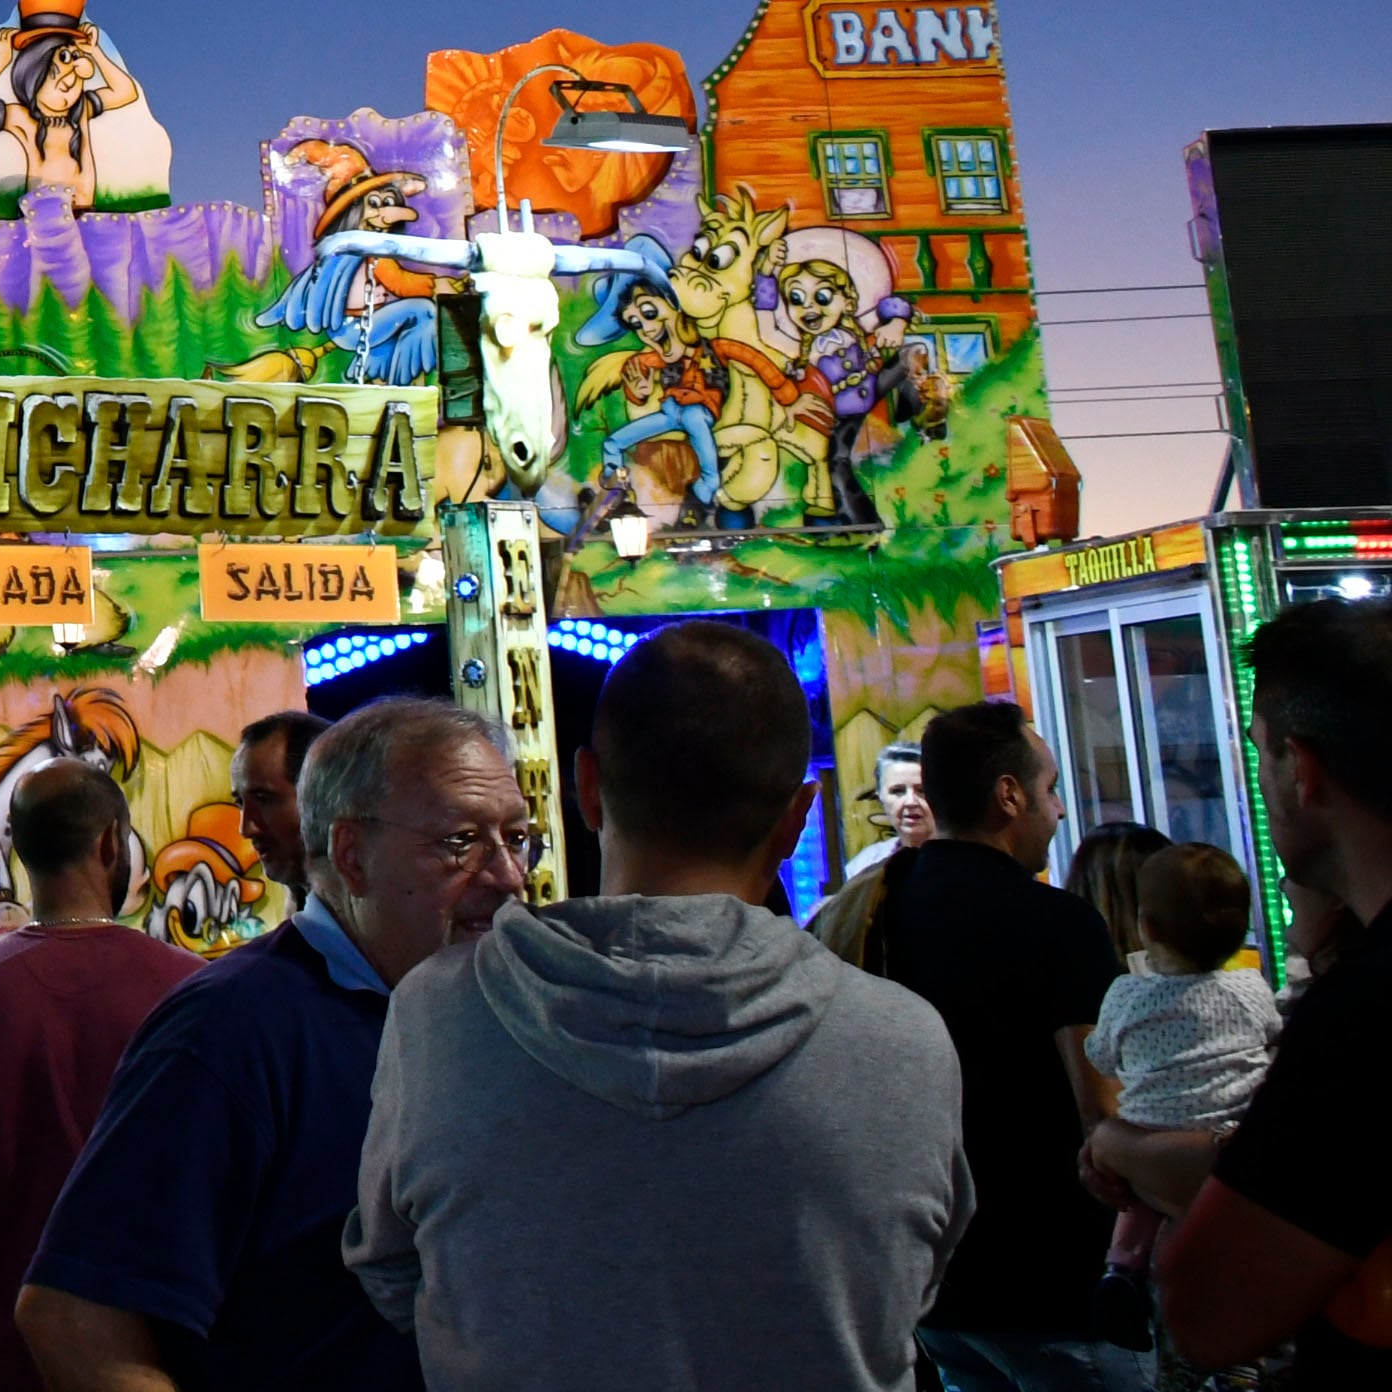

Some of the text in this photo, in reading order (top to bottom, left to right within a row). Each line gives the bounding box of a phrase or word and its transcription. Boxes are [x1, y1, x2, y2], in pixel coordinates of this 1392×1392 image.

[829, 8, 995, 64] BANK
[226, 563, 375, 601] SALIDA
[1064, 536, 1156, 586] TAQUILLA
